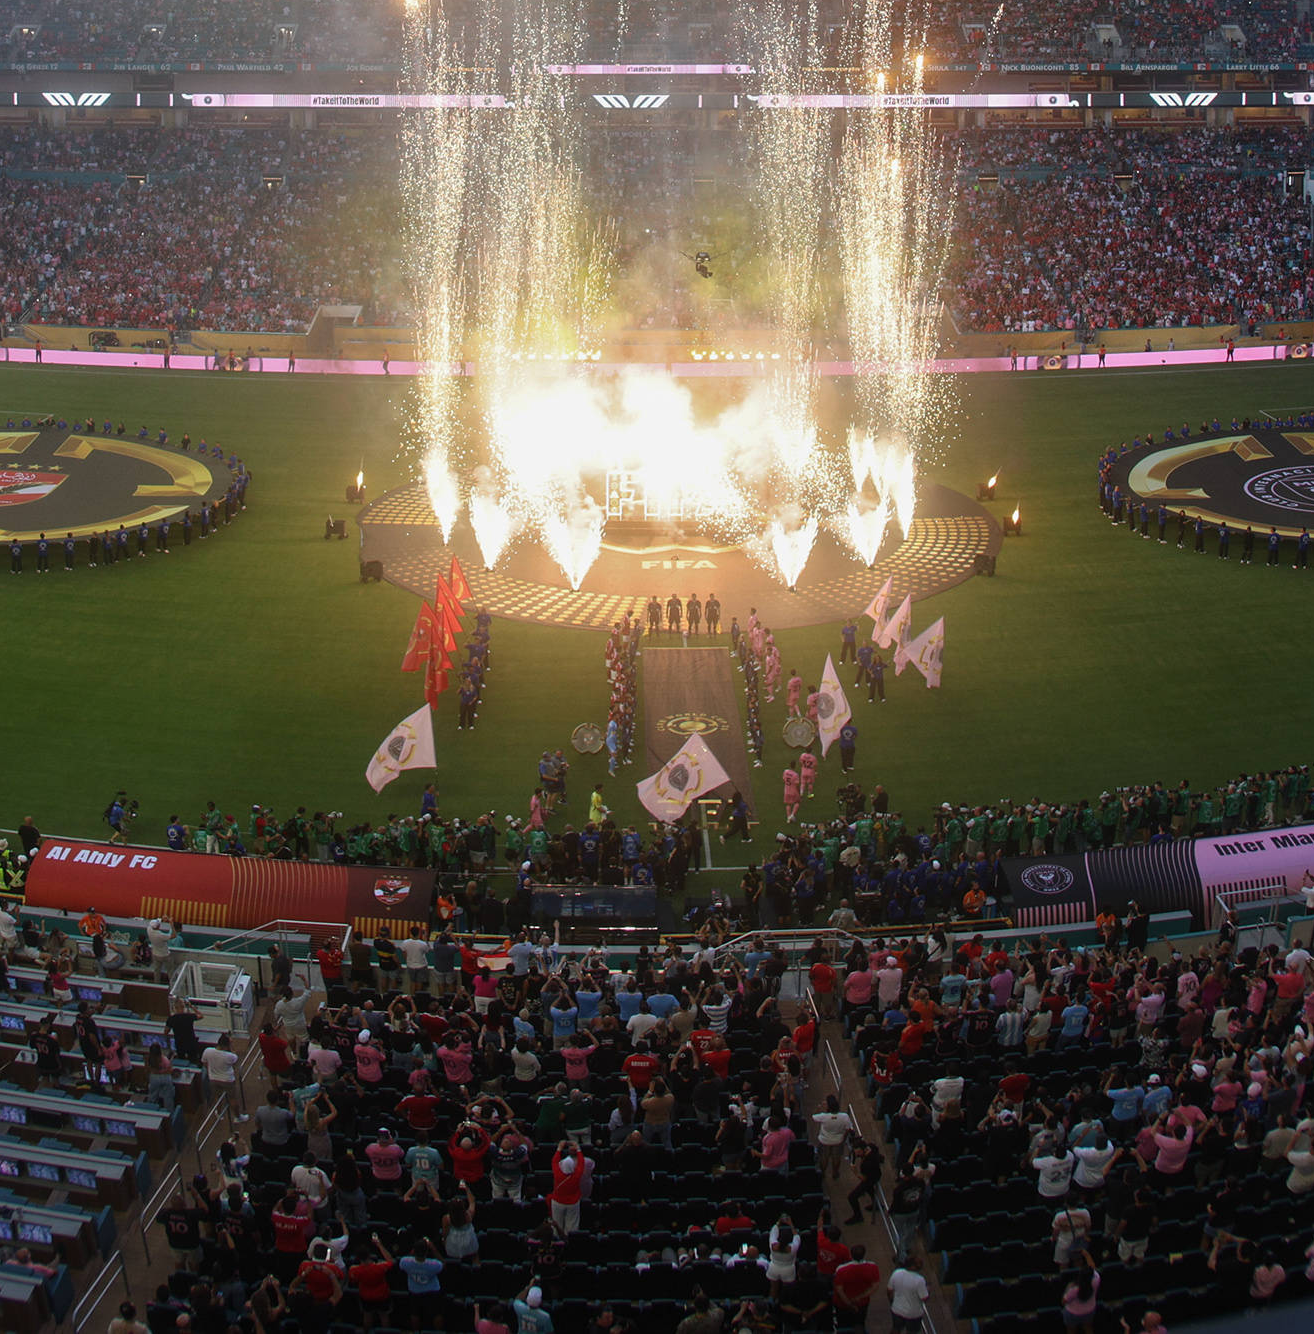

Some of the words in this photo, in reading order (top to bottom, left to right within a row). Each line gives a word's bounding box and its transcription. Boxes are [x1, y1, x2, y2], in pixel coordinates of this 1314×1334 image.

[312, 96, 380, 107] #TakeItToTheWorld
[641, 560, 718, 569] FIFA
[802, 759, 814, 769] 12
[785, 778, 792, 787] 5
[1213, 839, 1267, 857] Inter
[46, 846, 71, 861] Al
[73, 849, 125, 868] Ahly
[129, 854, 157, 869] FC
[415, 1159, 428, 1170] 10
[168, 1221, 188, 1234] 10
